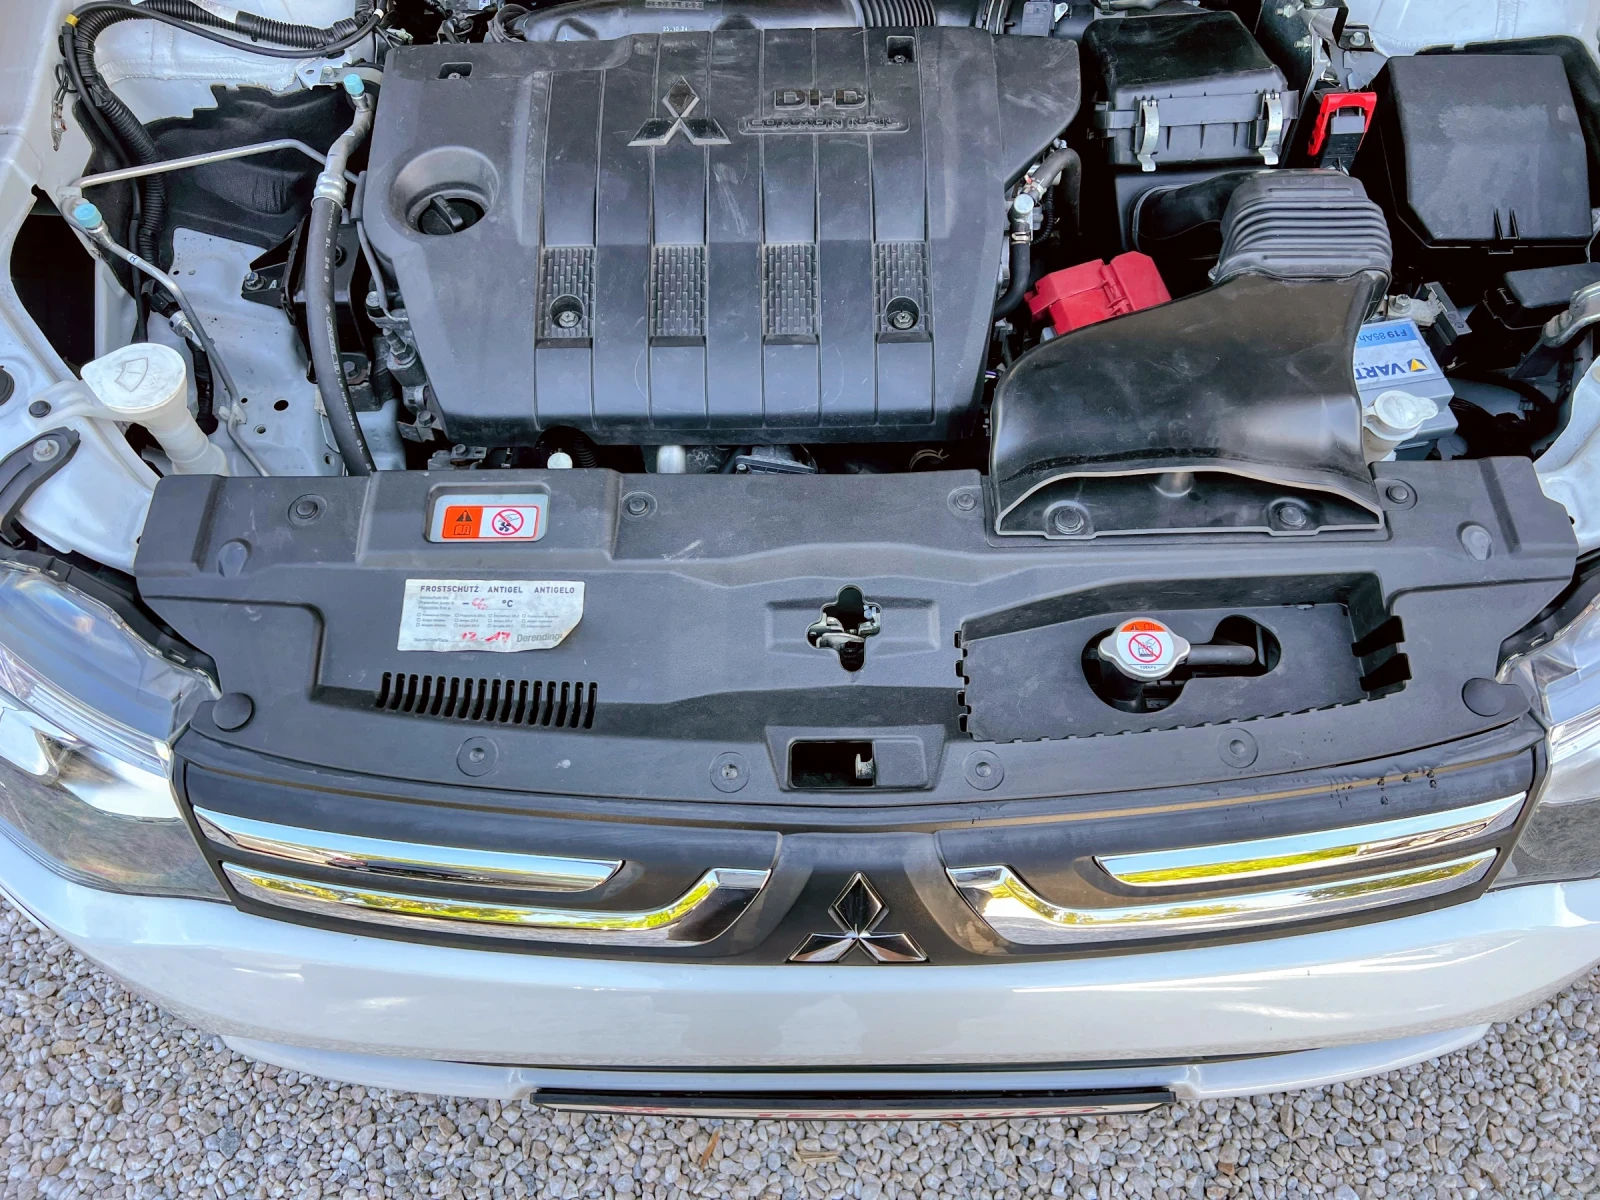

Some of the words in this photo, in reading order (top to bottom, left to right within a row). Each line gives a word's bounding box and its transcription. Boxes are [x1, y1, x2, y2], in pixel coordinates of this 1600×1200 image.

[1387, 329, 1408, 339] F19
[420, 585, 480, 593] FROSTSCHUTZ
[487, 586, 524, 594] ANTIGEL
